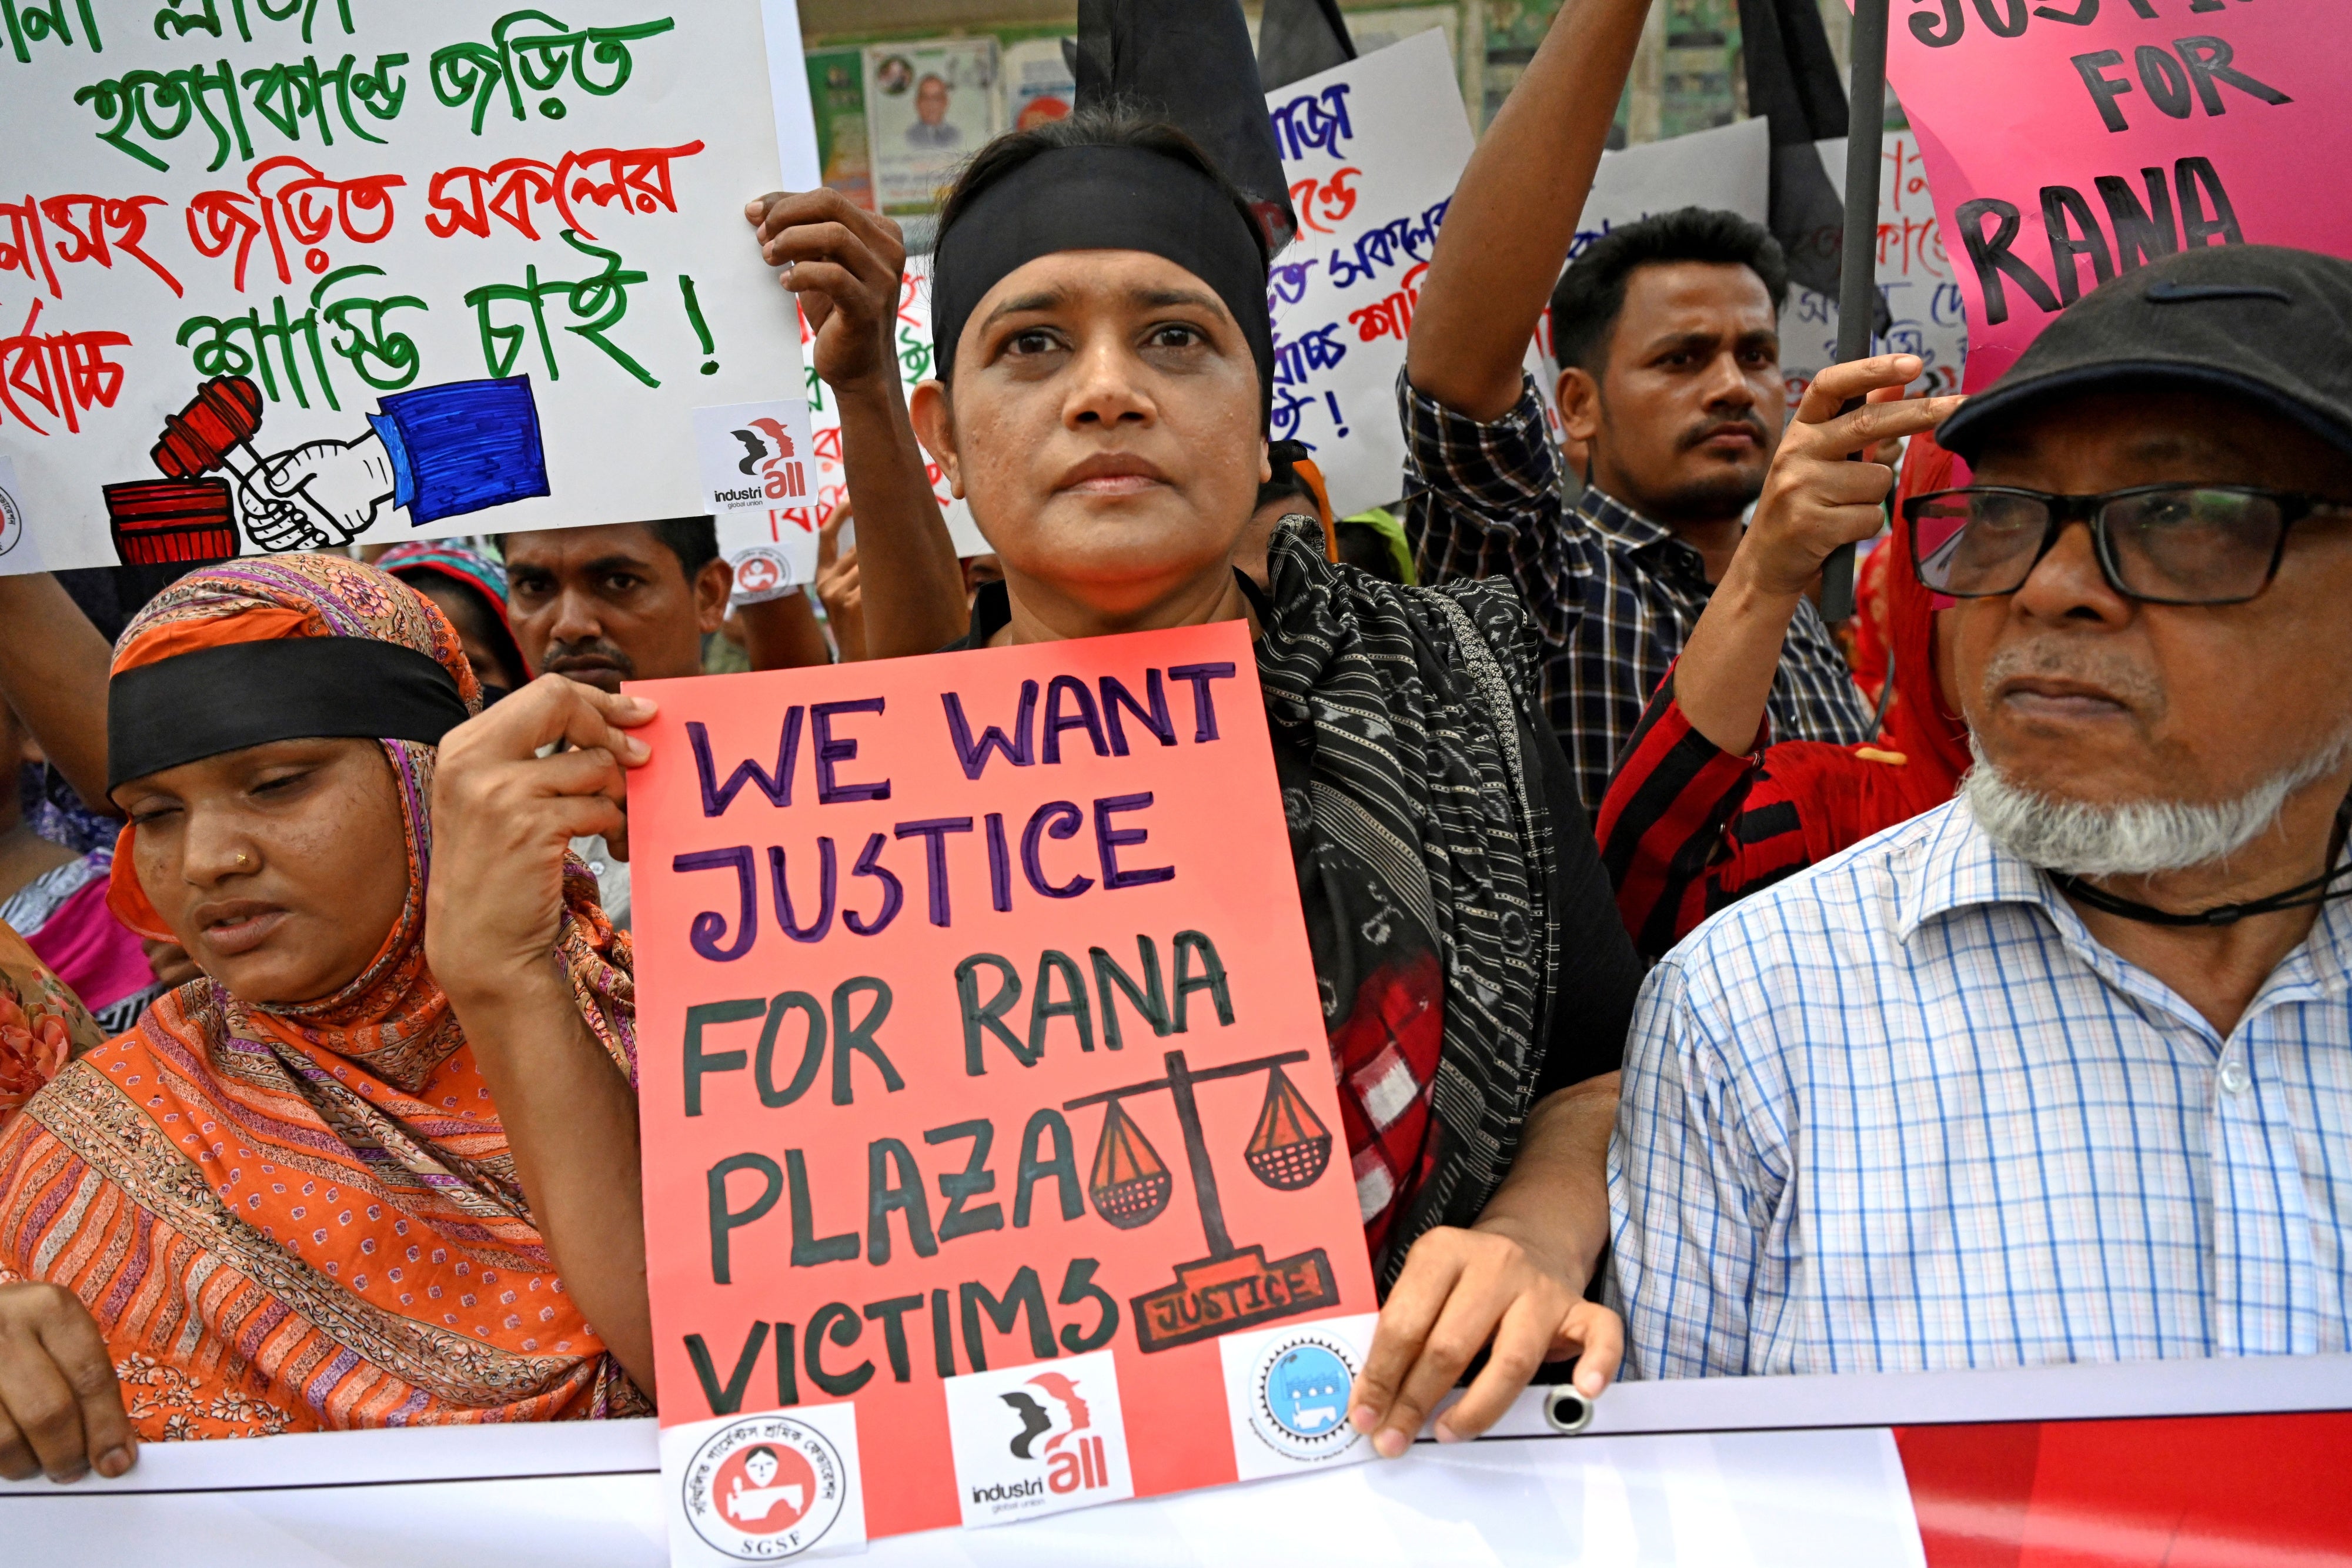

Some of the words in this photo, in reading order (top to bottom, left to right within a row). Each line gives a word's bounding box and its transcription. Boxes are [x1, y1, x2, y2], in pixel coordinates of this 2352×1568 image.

[430, 9, 675, 136] জড়িত
[2070, 36, 2294, 133] FOR
[186, 155, 407, 293] জড়িত
[1955, 157, 2246, 325] RANA
[464, 229, 661, 389] চাই
[727, 500, 746, 510] global
[684, 697, 891, 818] WE
[941, 661, 1236, 781] WANT
[672, 791, 1176, 962] JUSTICE
[683, 976, 905, 1117] FOR
[954, 930, 1235, 1076] RANA
[707, 1108, 1085, 1285] PLAZA
[683, 1258, 1120, 1416] VICTIMS
[1153, 1265, 1316, 1331] JUSTICE
[741, 1530, 803, 1556] SGSF
